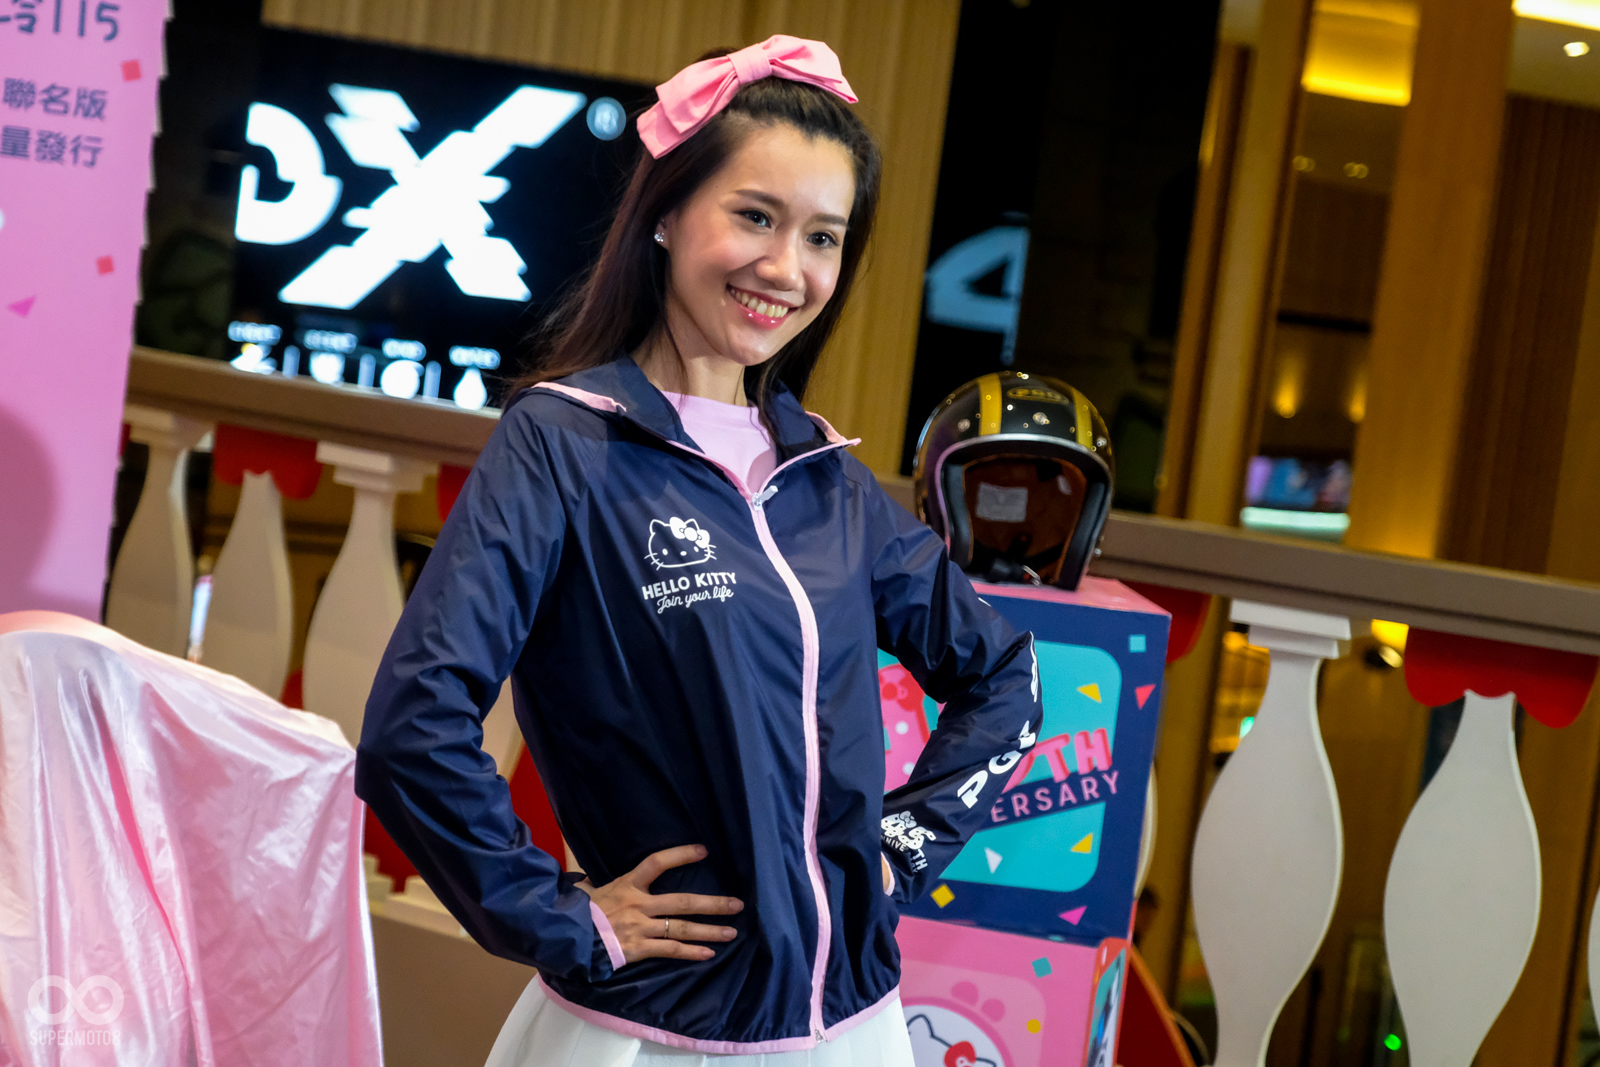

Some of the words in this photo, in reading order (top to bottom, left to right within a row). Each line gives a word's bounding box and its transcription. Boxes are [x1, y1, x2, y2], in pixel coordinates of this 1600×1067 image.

[3, 77, 107, 121] 聯名版
[0, 125, 103, 168] 量發行
[641, 576, 690, 600] HELLO
[694, 572, 737, 588] KITTY
[656, 595, 684, 614] Join
[685, 590, 711, 608] your
[712, 585, 734, 602] life
